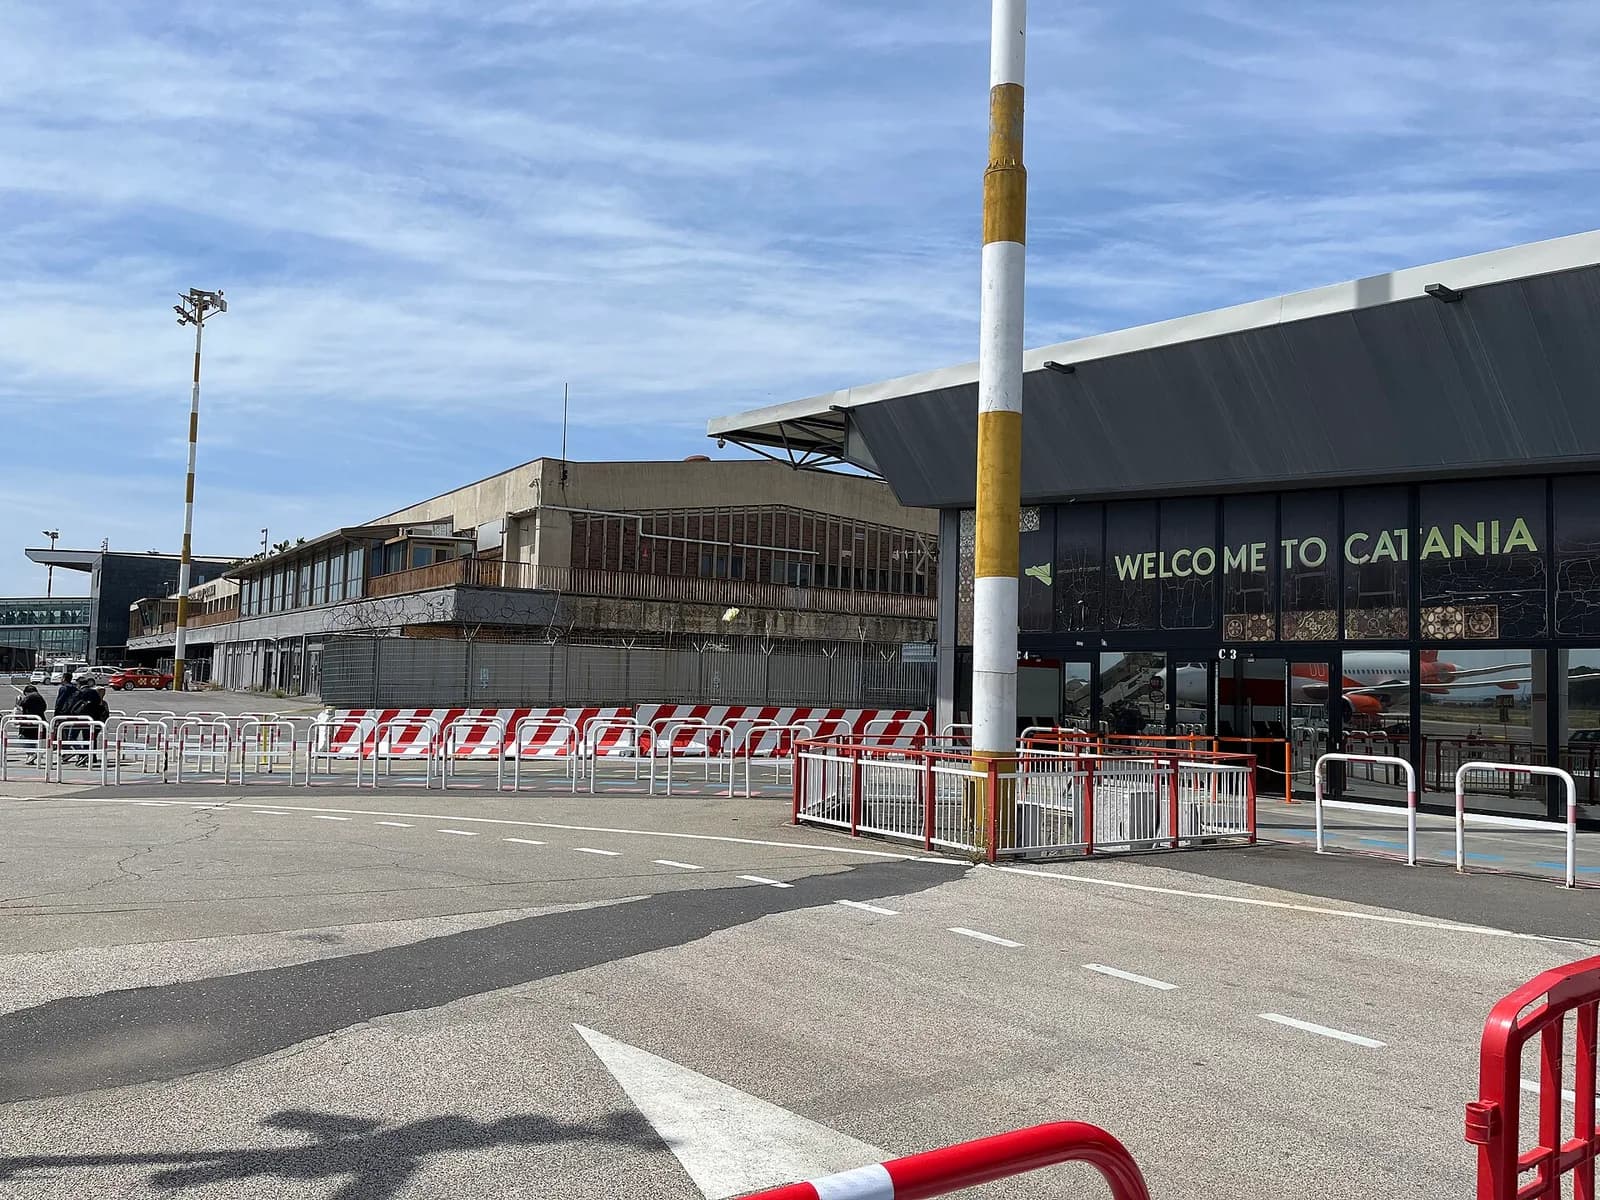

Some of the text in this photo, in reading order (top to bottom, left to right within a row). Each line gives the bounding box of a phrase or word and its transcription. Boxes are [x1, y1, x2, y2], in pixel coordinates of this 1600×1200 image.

[1114, 517, 1538, 581] WELCOME TO CATANIA
